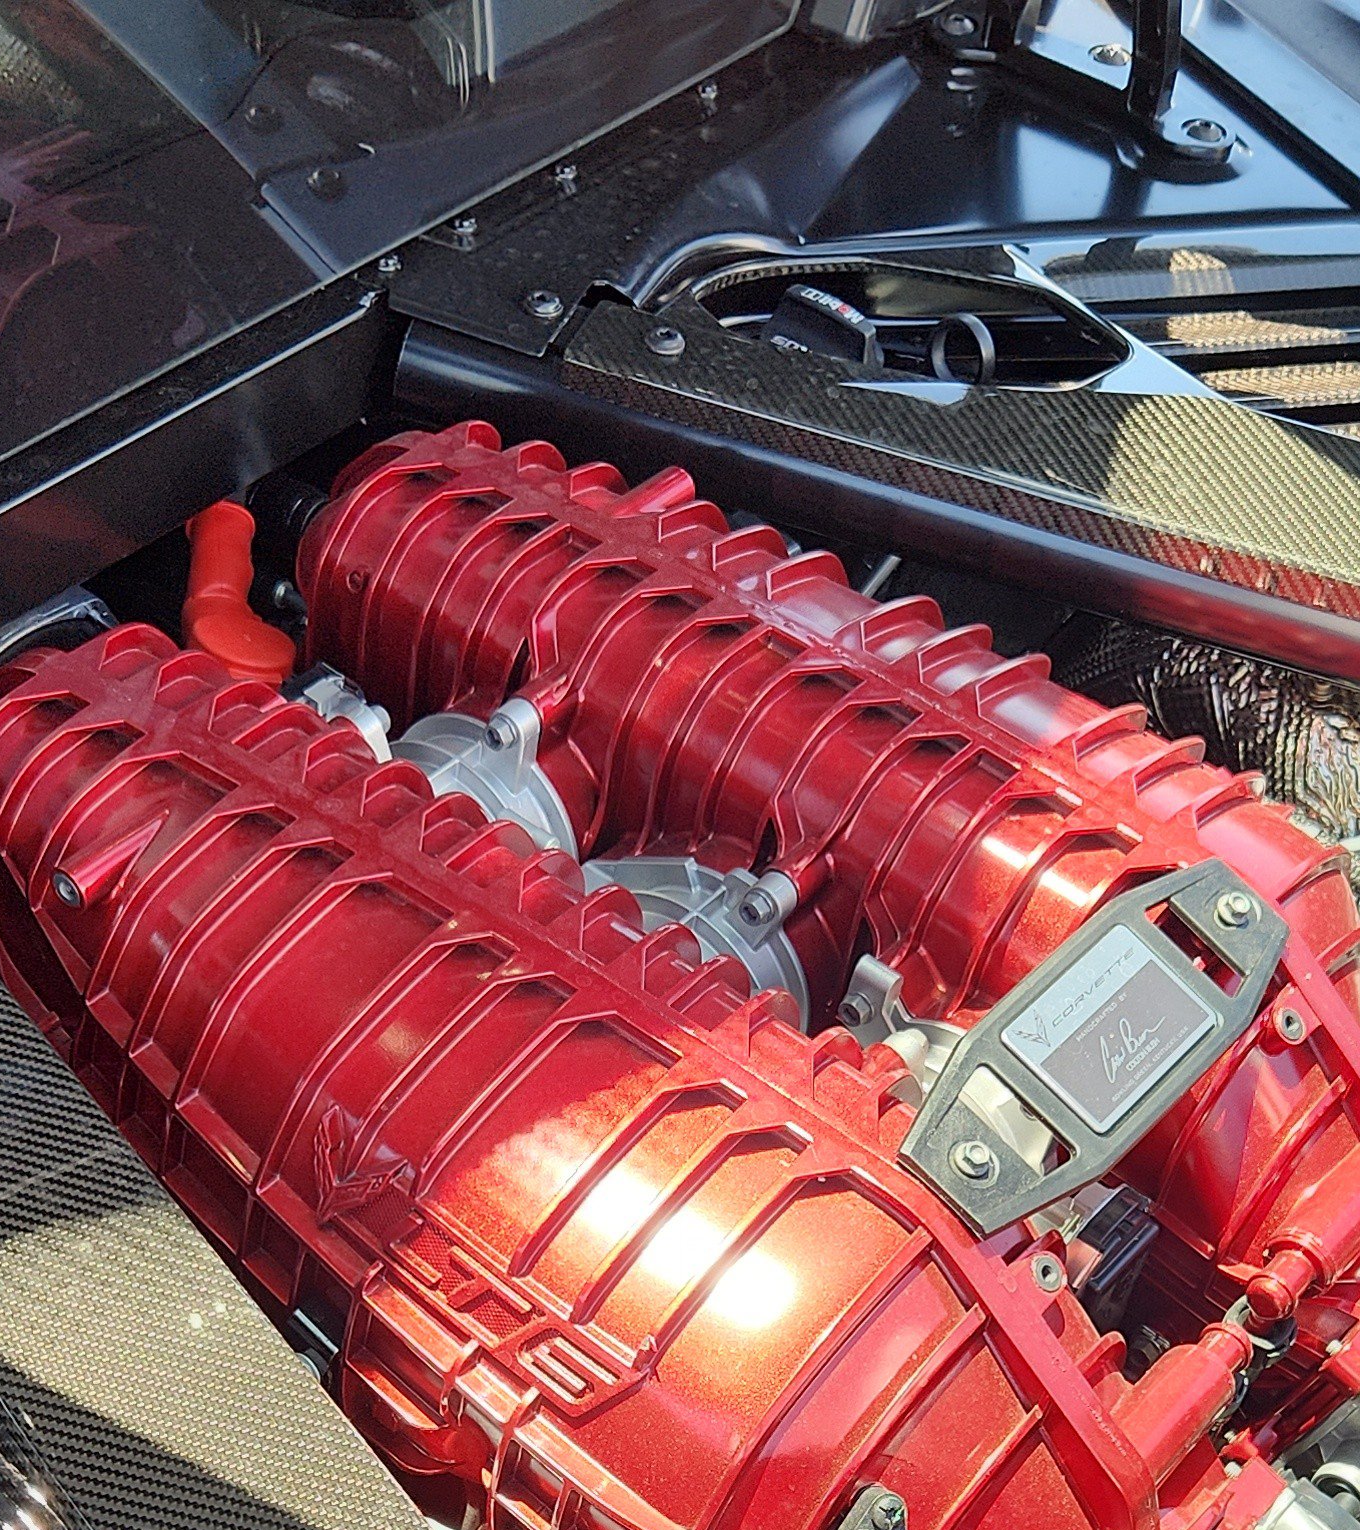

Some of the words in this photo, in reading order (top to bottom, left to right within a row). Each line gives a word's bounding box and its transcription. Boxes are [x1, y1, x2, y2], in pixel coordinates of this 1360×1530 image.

[1052, 947, 1135, 1028] CORVETTE
[1075, 1002, 1118, 1042] HANDCRAFTED
[1118, 993, 1128, 1002] BY
